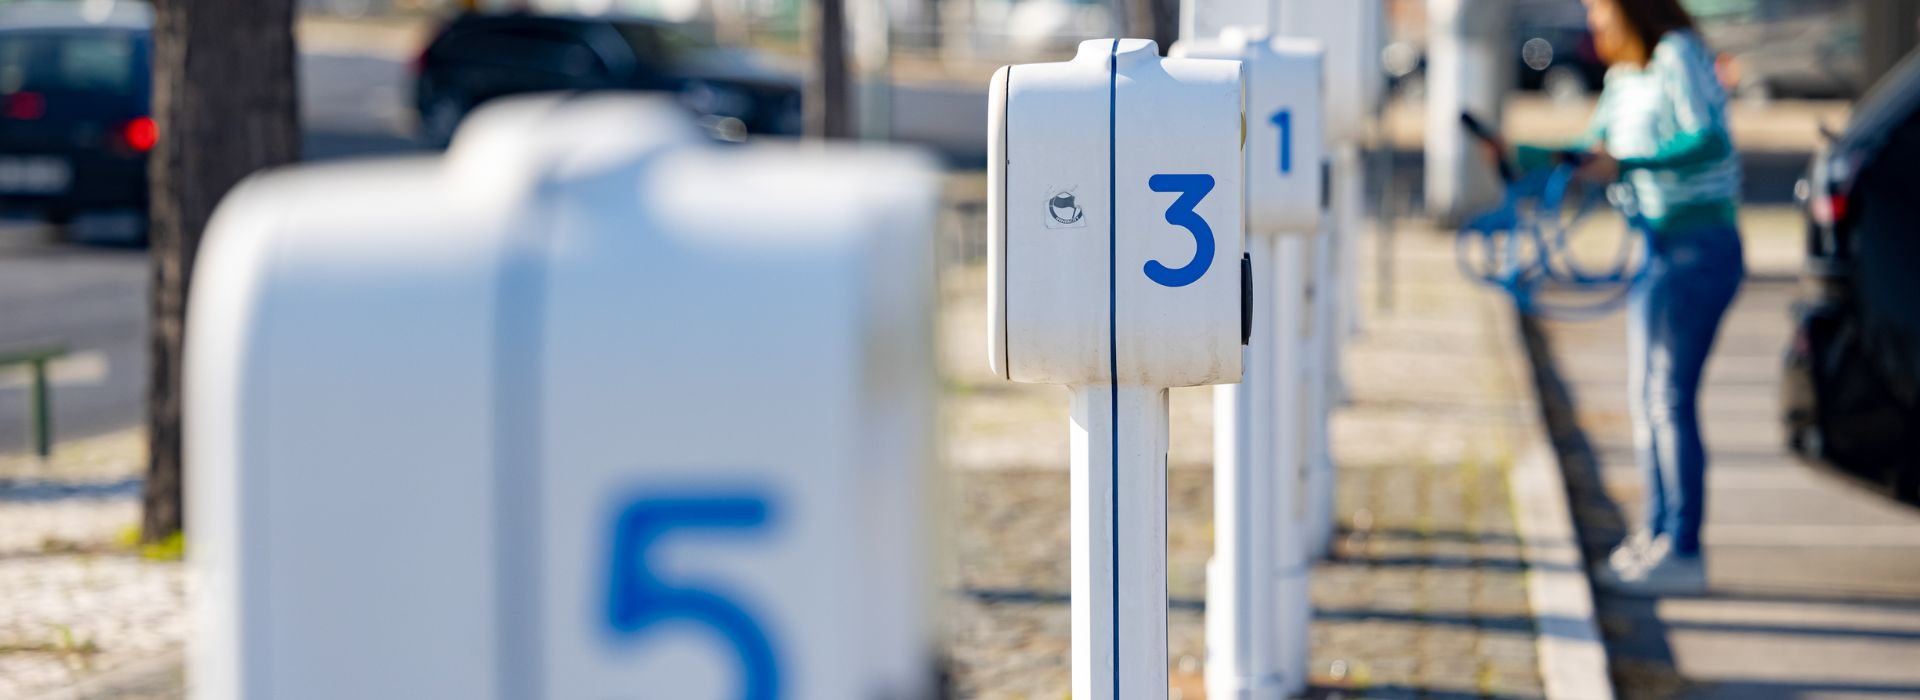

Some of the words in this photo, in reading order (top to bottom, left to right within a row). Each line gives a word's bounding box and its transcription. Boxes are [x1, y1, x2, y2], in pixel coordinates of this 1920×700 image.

[1268, 107, 1293, 175] 1
[1143, 173, 1216, 288] 3
[600, 487, 786, 700] 5
